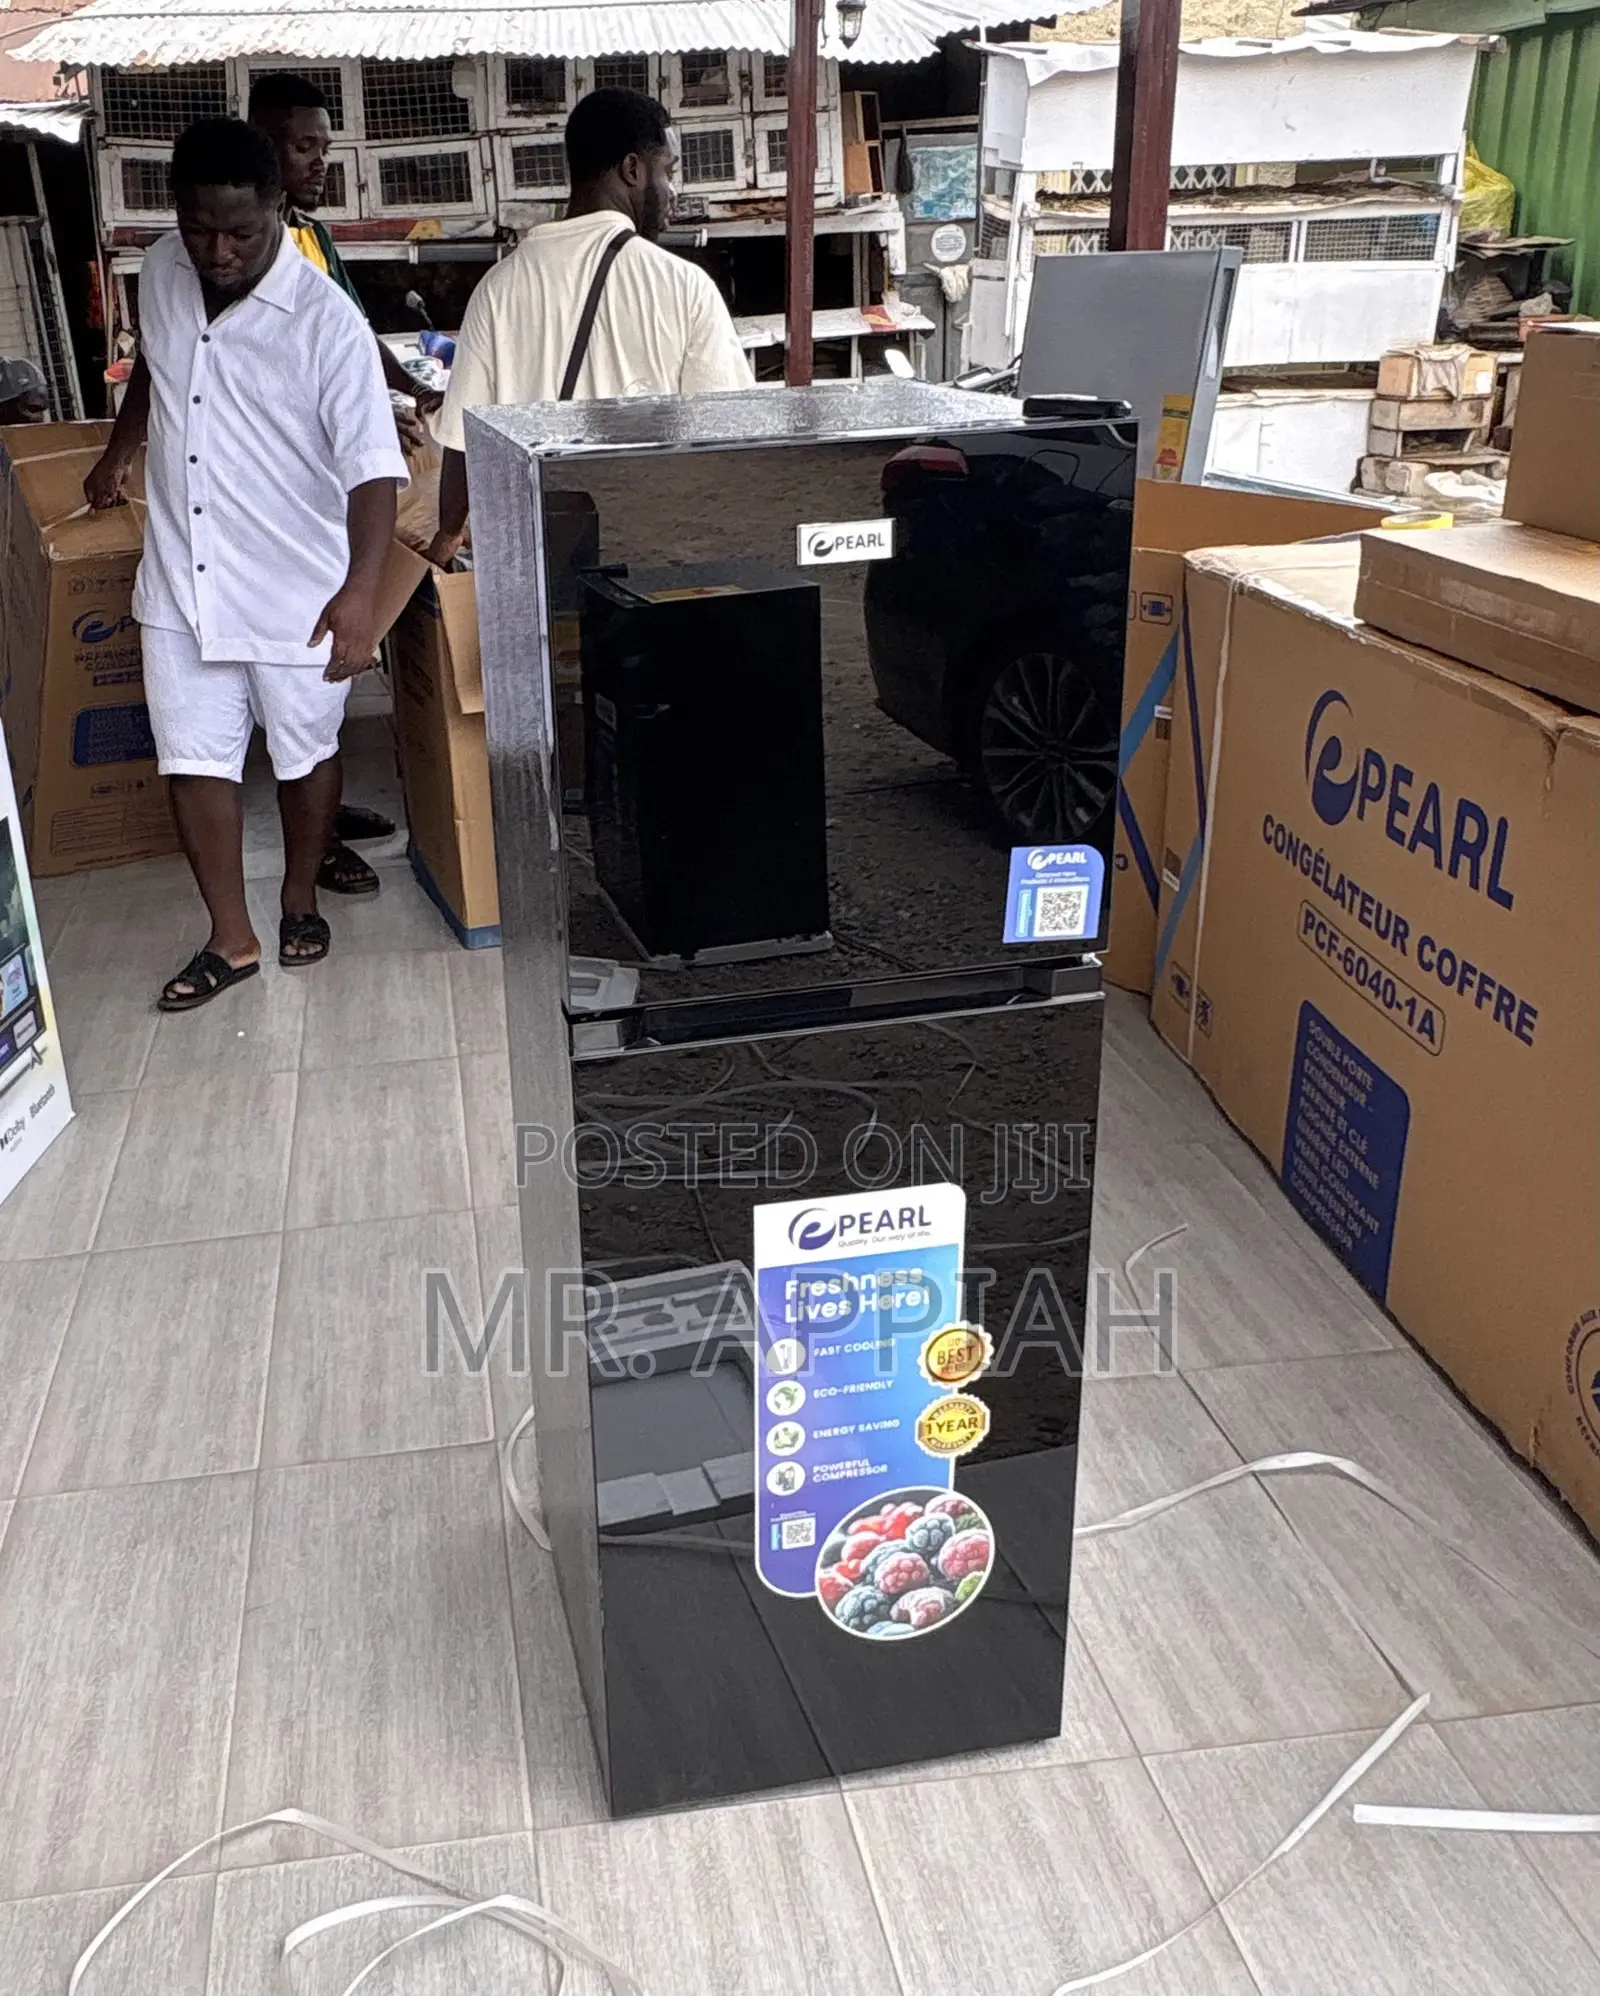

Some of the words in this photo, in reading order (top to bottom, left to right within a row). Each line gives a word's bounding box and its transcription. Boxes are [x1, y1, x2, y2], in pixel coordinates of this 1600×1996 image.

[834, 532, 886, 551] PEARL
[1356, 747, 1515, 912] PEARL
[1047, 851, 1088, 865] PEARL
[1261, 813, 1411, 957] CONGÉLATEUR
[1416, 934, 1539, 1048] COFFRE
[1302, 908, 1437, 1046] PCF-6040-1A
[838, 1204, 932, 1238] PEARL
[784, 1267, 923, 1301] Freshness
[784, 1299, 853, 1324] Lives
[859, 1286, 931, 1315] Here!
[813, 1345, 842, 1357] FAST
[844, 1338, 896, 1353] COOLING
[936, 1345, 975, 1366] BEST
[812, 1379, 894, 1399] ECO-FRIENDLY
[812, 1425, 855, 1439] ENERGY
[858, 1418, 901, 1433] SAVING
[935, 1416, 979, 1433] YEAR
[812, 1458, 871, 1473] POWERFUL
[812, 1464, 889, 1483] COMPRESSOR
